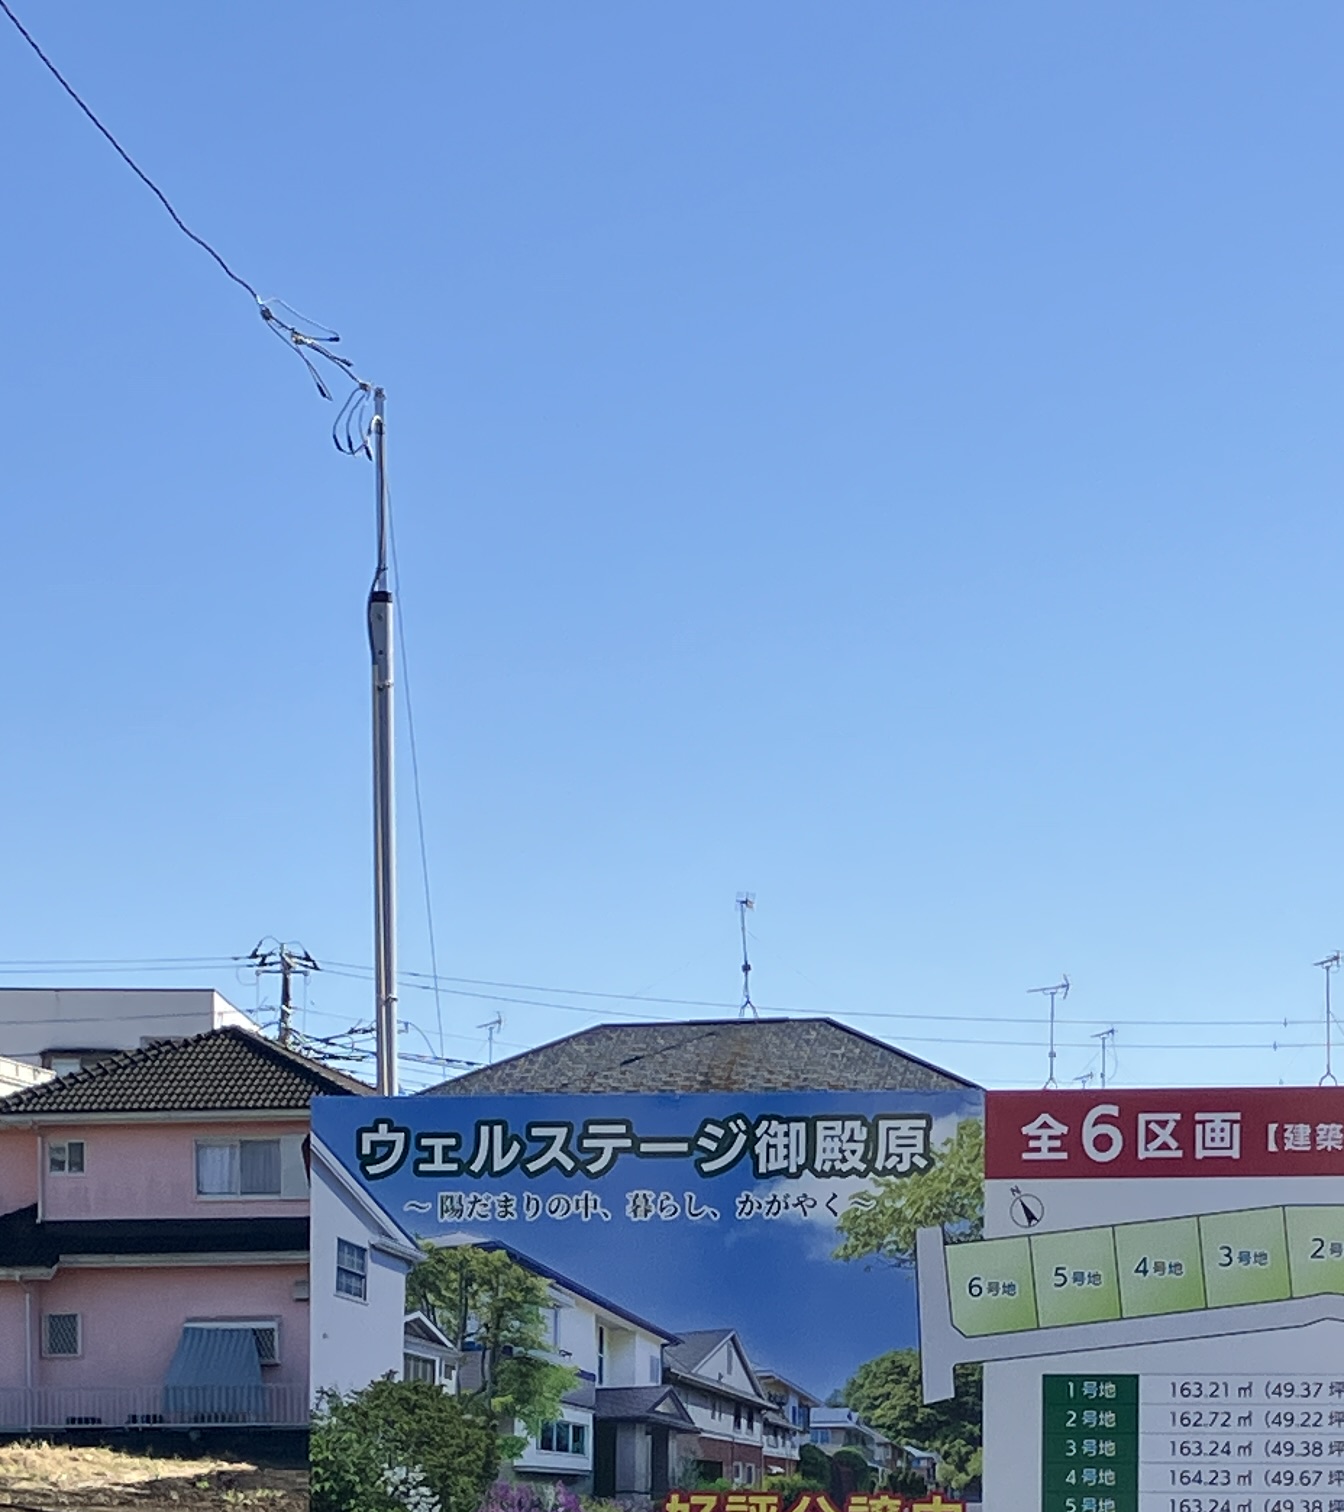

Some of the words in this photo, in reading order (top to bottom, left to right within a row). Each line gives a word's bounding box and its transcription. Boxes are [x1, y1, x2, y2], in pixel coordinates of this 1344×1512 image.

[359, 1117, 930, 1178] ウェルステージ御殿原
[1020, 1103, 1242, 1163] 全6区画
